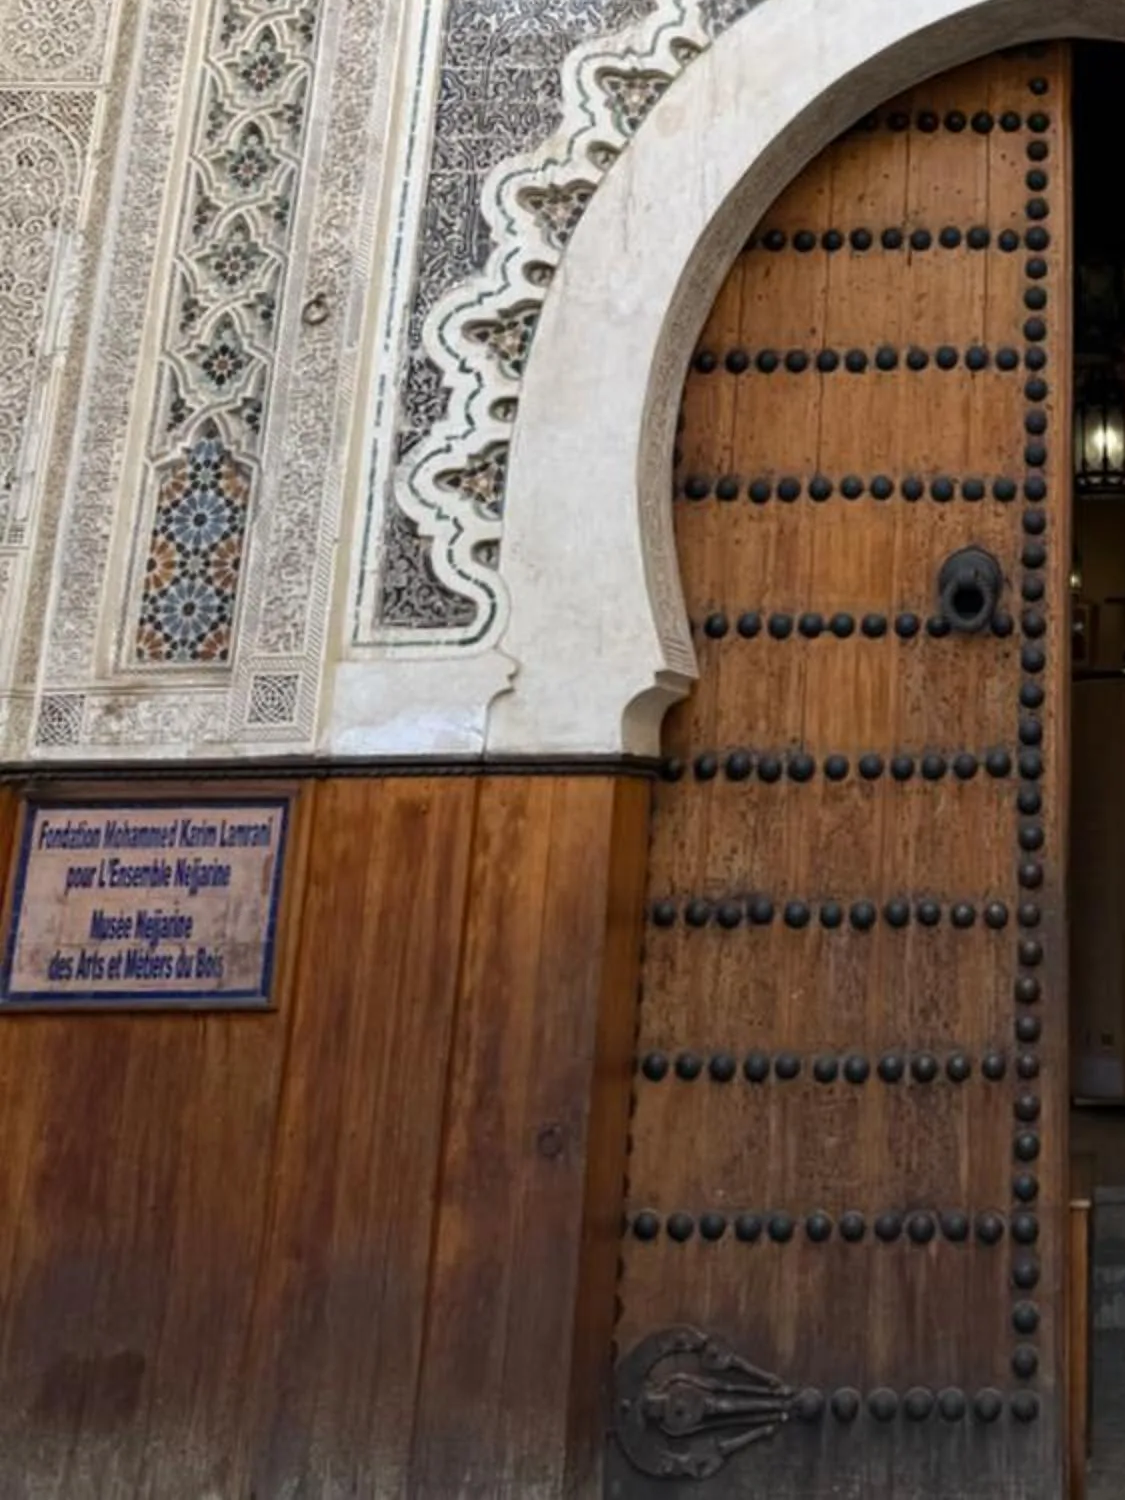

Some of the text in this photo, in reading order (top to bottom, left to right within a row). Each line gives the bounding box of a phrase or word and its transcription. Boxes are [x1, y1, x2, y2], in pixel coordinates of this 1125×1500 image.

[39, 816, 273, 850] Fondation Mohammed Karim Lamrani
[64, 864, 97, 895] pour
[90, 910, 132, 941] Musée
[47, 950, 74, 981] des
[75, 949, 104, 980] Arts
[106, 953, 122, 980] et
[174, 948, 194, 979] du
[195, 947, 223, 979] Bois
